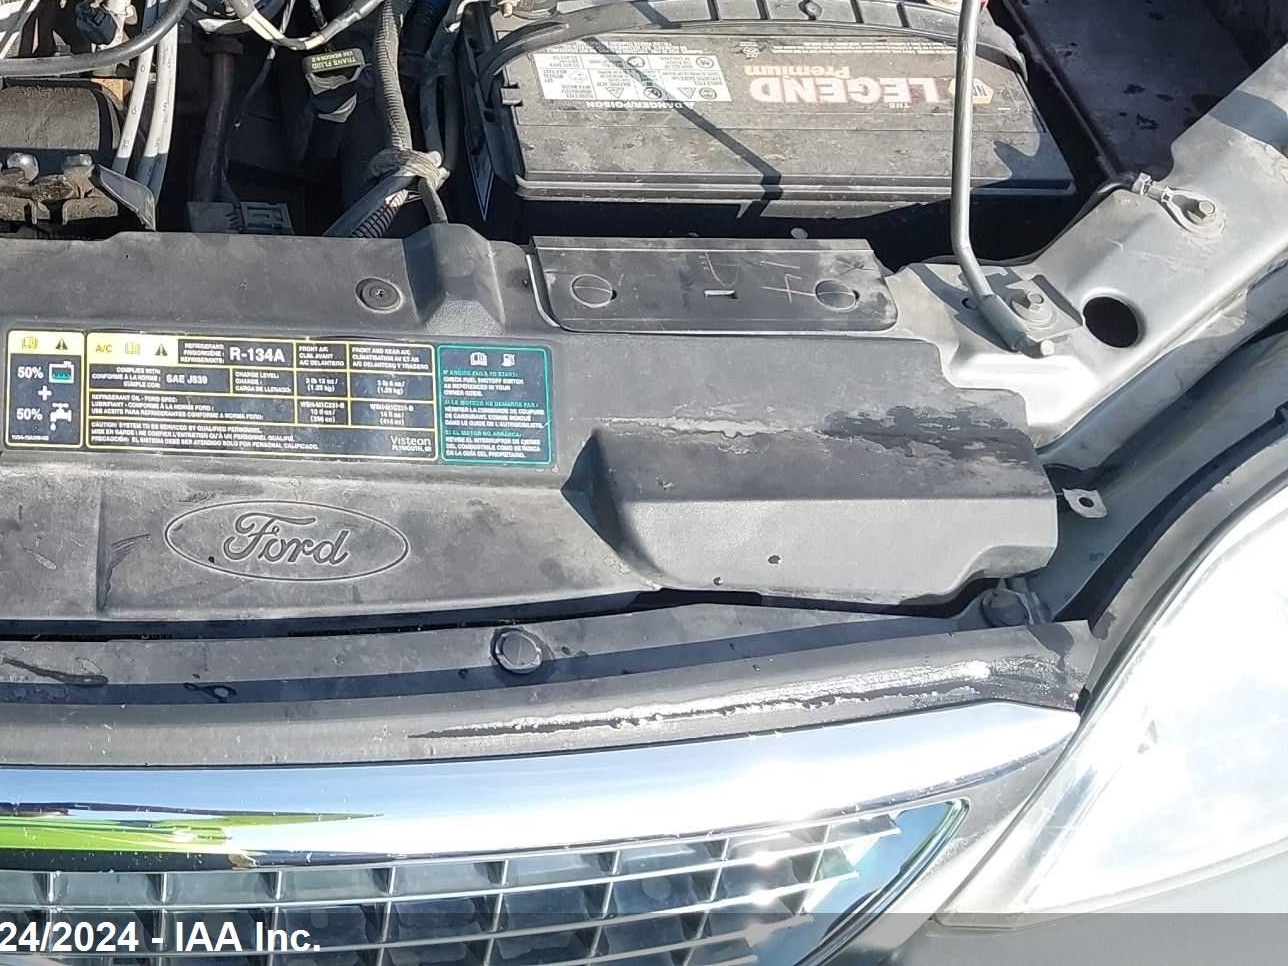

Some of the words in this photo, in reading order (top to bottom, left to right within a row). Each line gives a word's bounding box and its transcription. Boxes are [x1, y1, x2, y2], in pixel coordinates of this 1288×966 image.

[312, 61, 331, 70] FLUID
[333, 57, 356, 66] TRANS
[744, 65, 850, 78] Premium
[750, 77, 939, 104] LEGEND
[585, 101, 682, 110] DANGER/POISON
[96, 345, 112, 353] A/C
[230, 347, 285, 362] R-134A
[17, 366, 44, 380] 50%
[167, 375, 184, 383] SAE
[16, 408, 43, 422] 50%
[390, 436, 431, 445] Visteon
[222, 511, 350, 566] Ford
